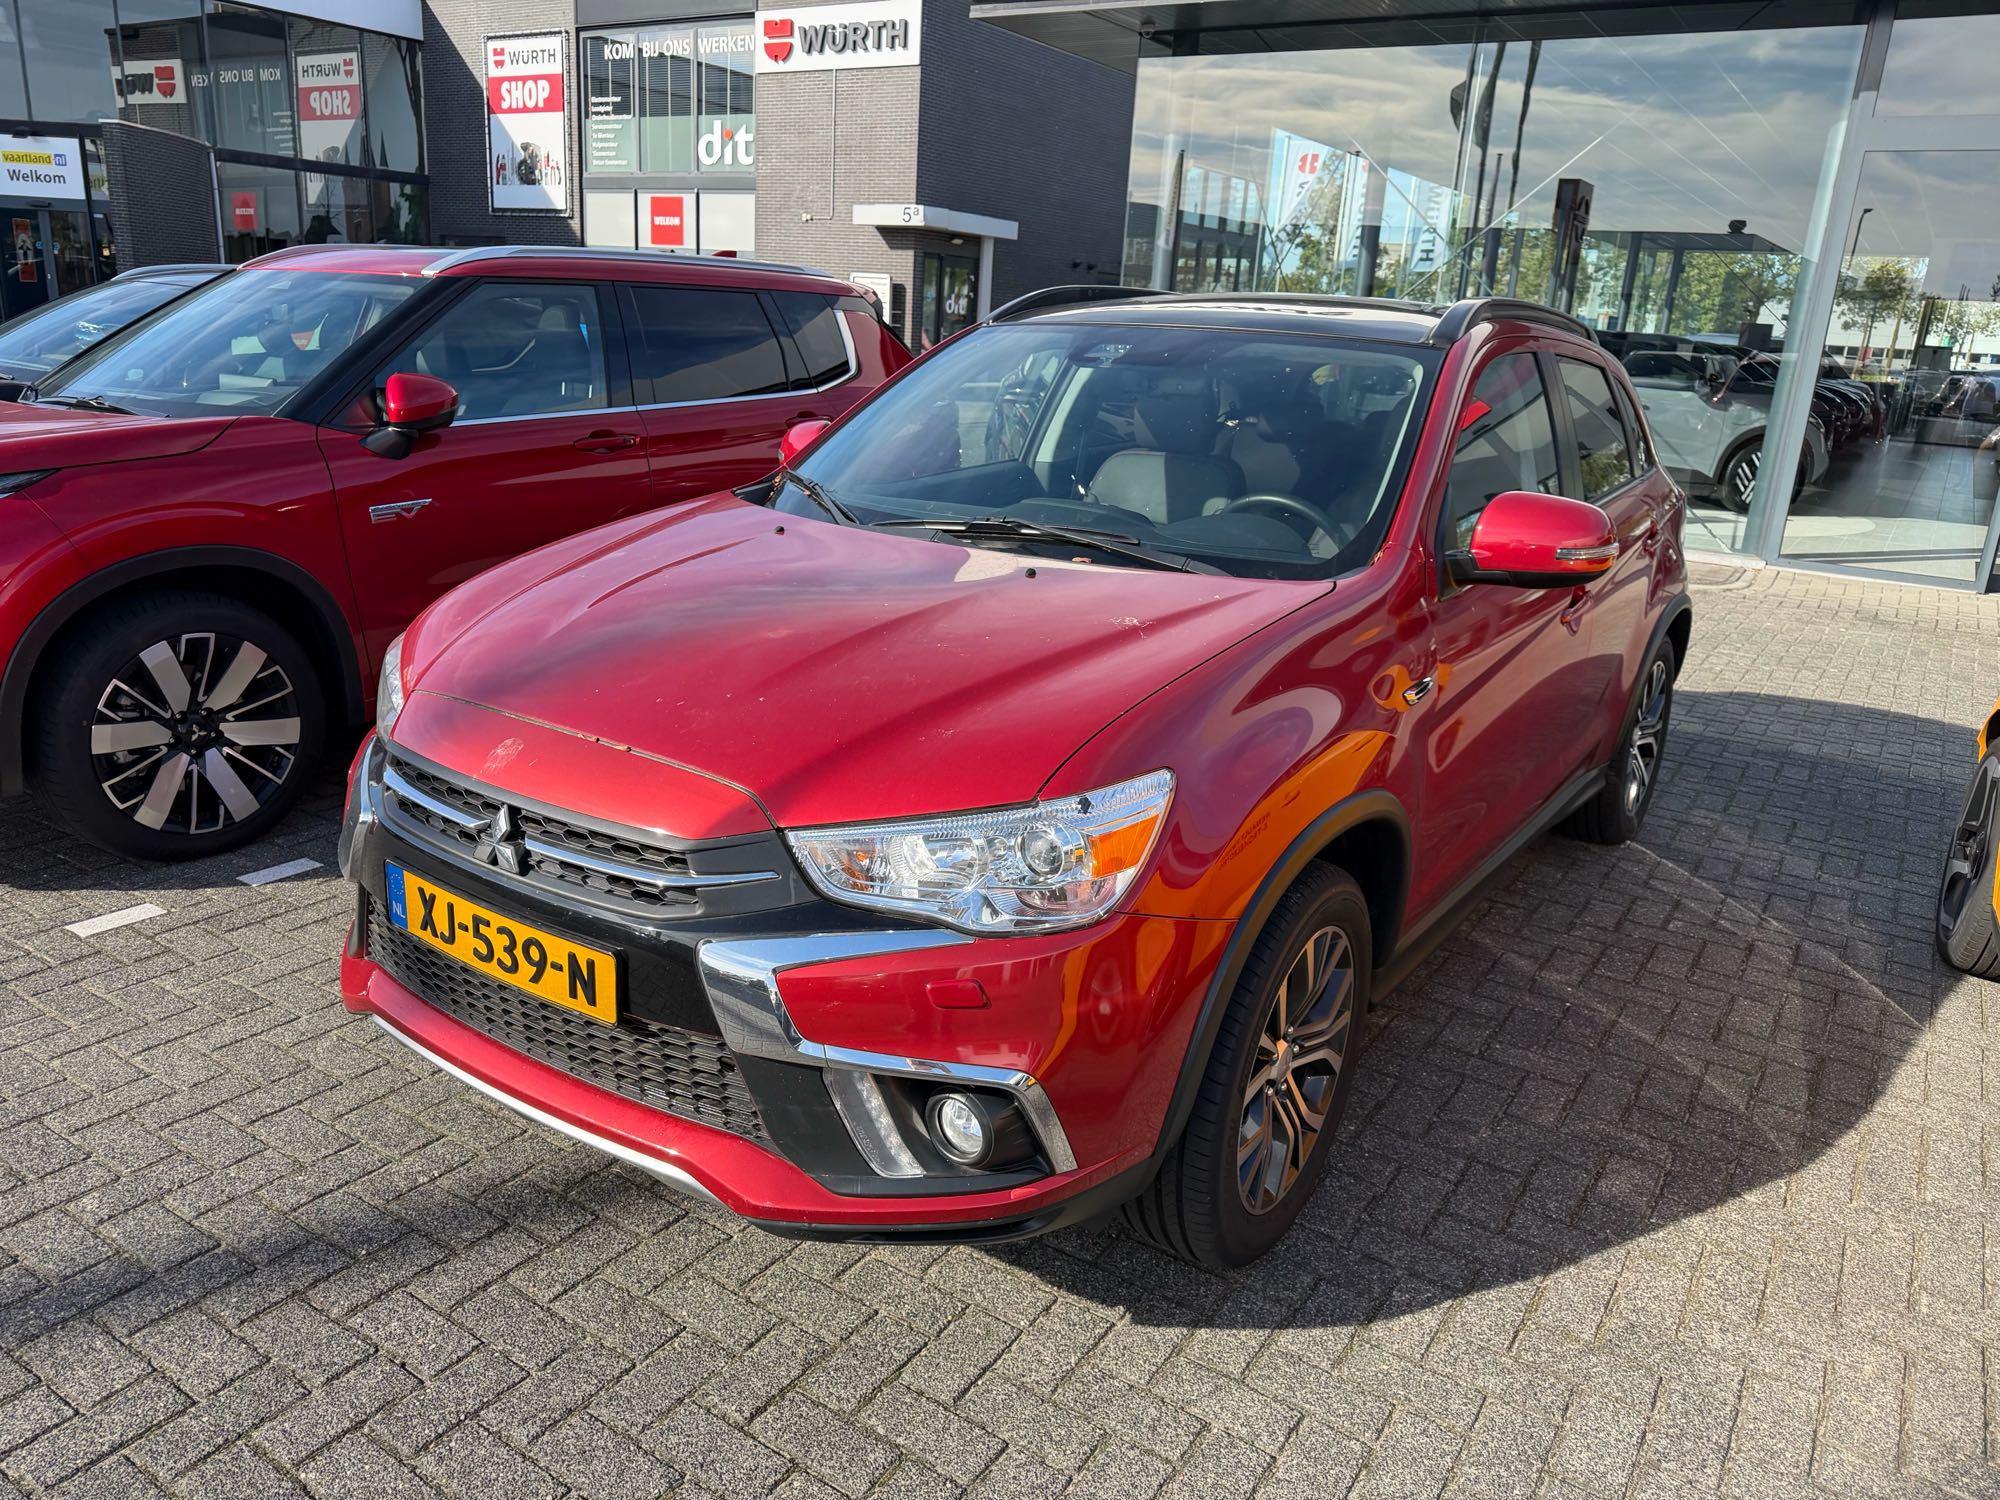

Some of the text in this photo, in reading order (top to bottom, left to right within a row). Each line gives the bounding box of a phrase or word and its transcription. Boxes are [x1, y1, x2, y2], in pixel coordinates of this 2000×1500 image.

[604, 35, 754, 60] KOM BIJ ONS WERKEN
[798, 19, 908, 55] WÜRTH
[509, 48, 556, 65] WÜRTH
[500, 79, 550, 110] SHOP
[698, 120, 753, 166] dit
[7, 169, 66, 184] Welkom
[393, 901, 406, 919] NL
[417, 886, 597, 1007] XJ-539-N
